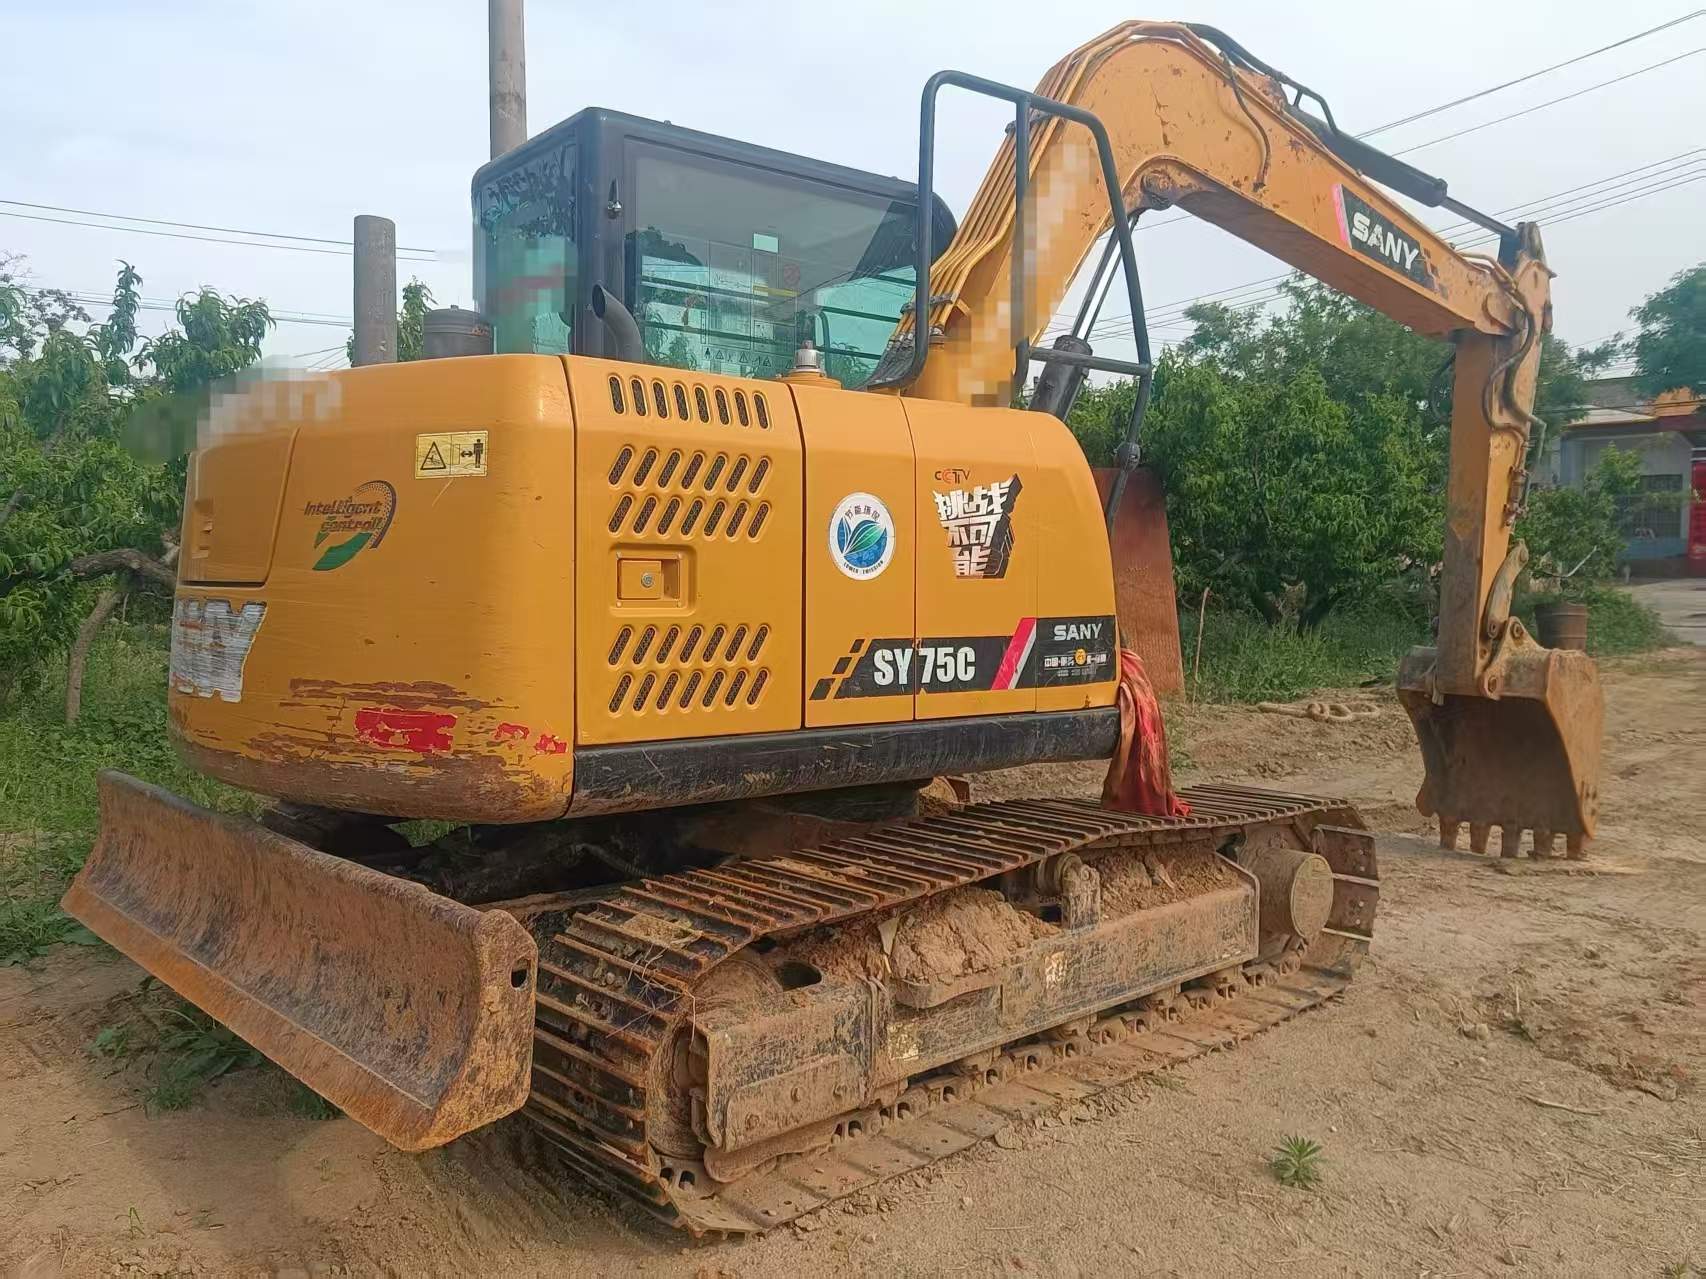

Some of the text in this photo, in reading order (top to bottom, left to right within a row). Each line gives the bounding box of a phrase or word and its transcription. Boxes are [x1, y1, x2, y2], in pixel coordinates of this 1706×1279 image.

[1352, 212, 1419, 270] SANY
[934, 468, 970, 484] CCTV
[304, 496, 383, 518] Intelligent
[932, 476, 1013, 521] 挑战
[940, 513, 1003, 547] 不可
[947, 545, 992, 576] 能
[1053, 623, 1102, 641] SANY
